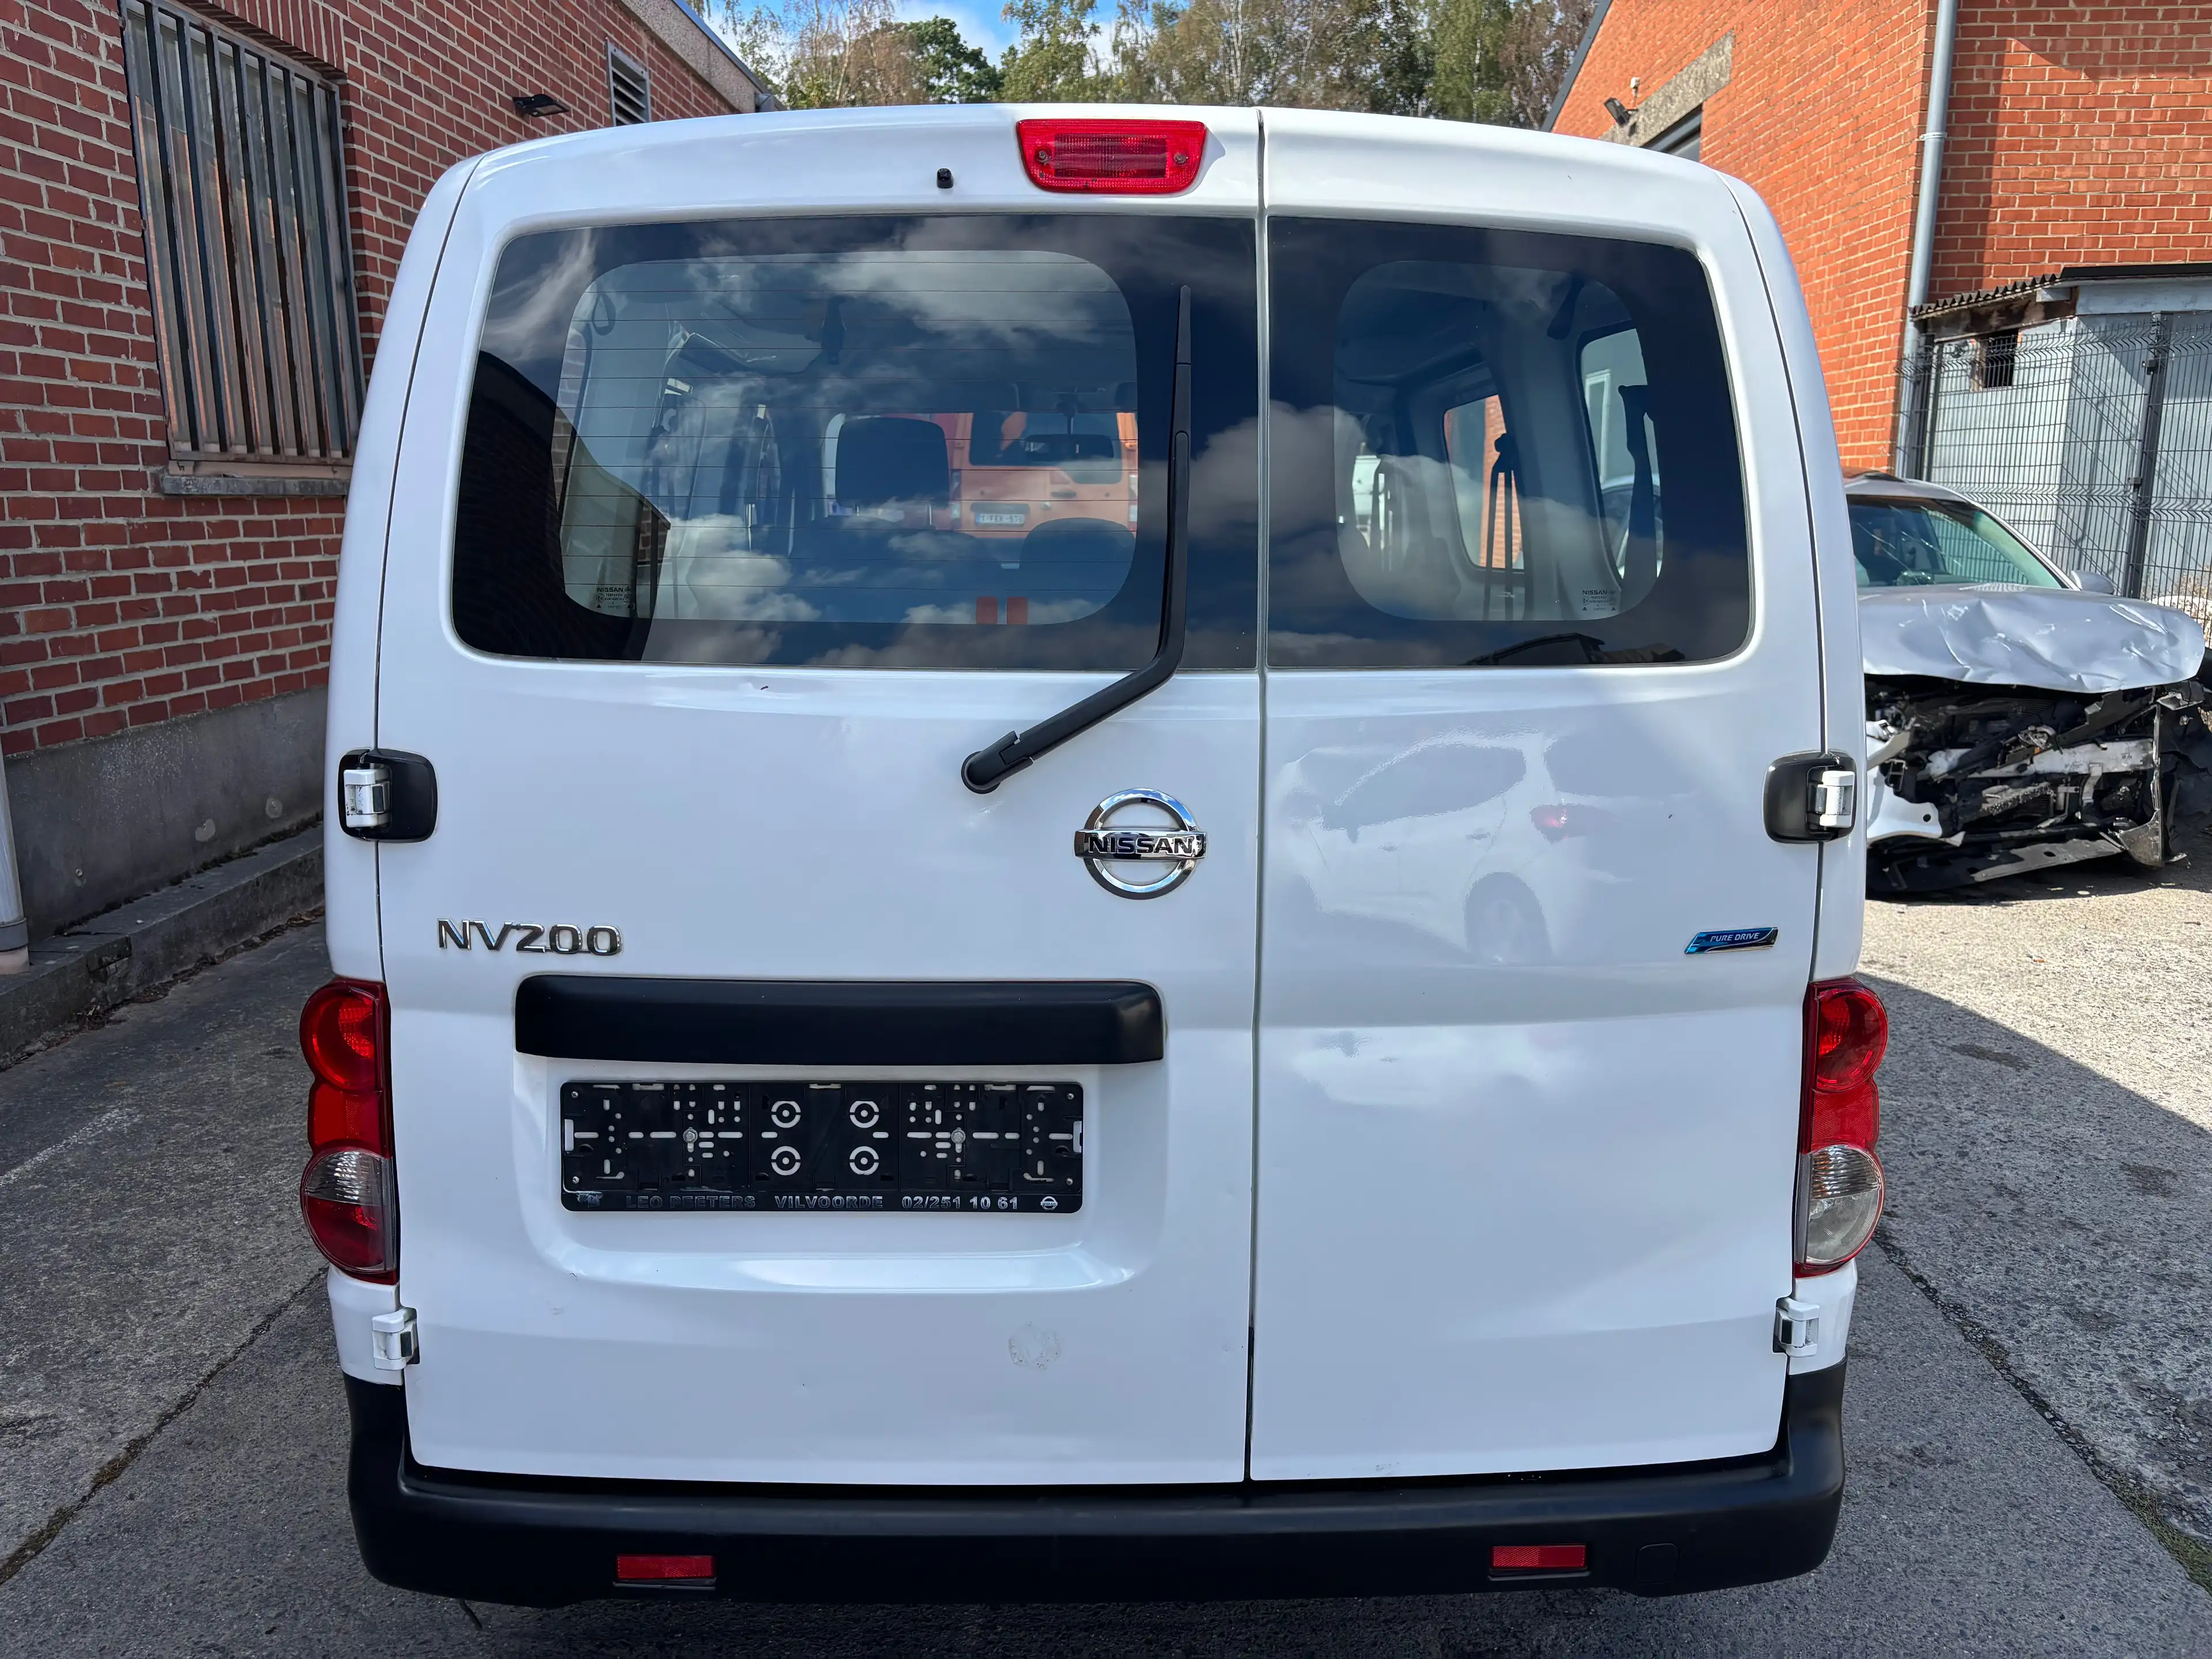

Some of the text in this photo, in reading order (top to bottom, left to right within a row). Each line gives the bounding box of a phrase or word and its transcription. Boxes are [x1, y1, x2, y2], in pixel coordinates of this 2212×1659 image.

[1088, 836, 1194, 854] NISSAN
[438, 918, 622, 956] NV200
[1710, 933, 1760, 942] PURE DRIVE
[627, 1195, 1018, 1210] LEO PEETERS VILVOORDE 02/251 10 61
